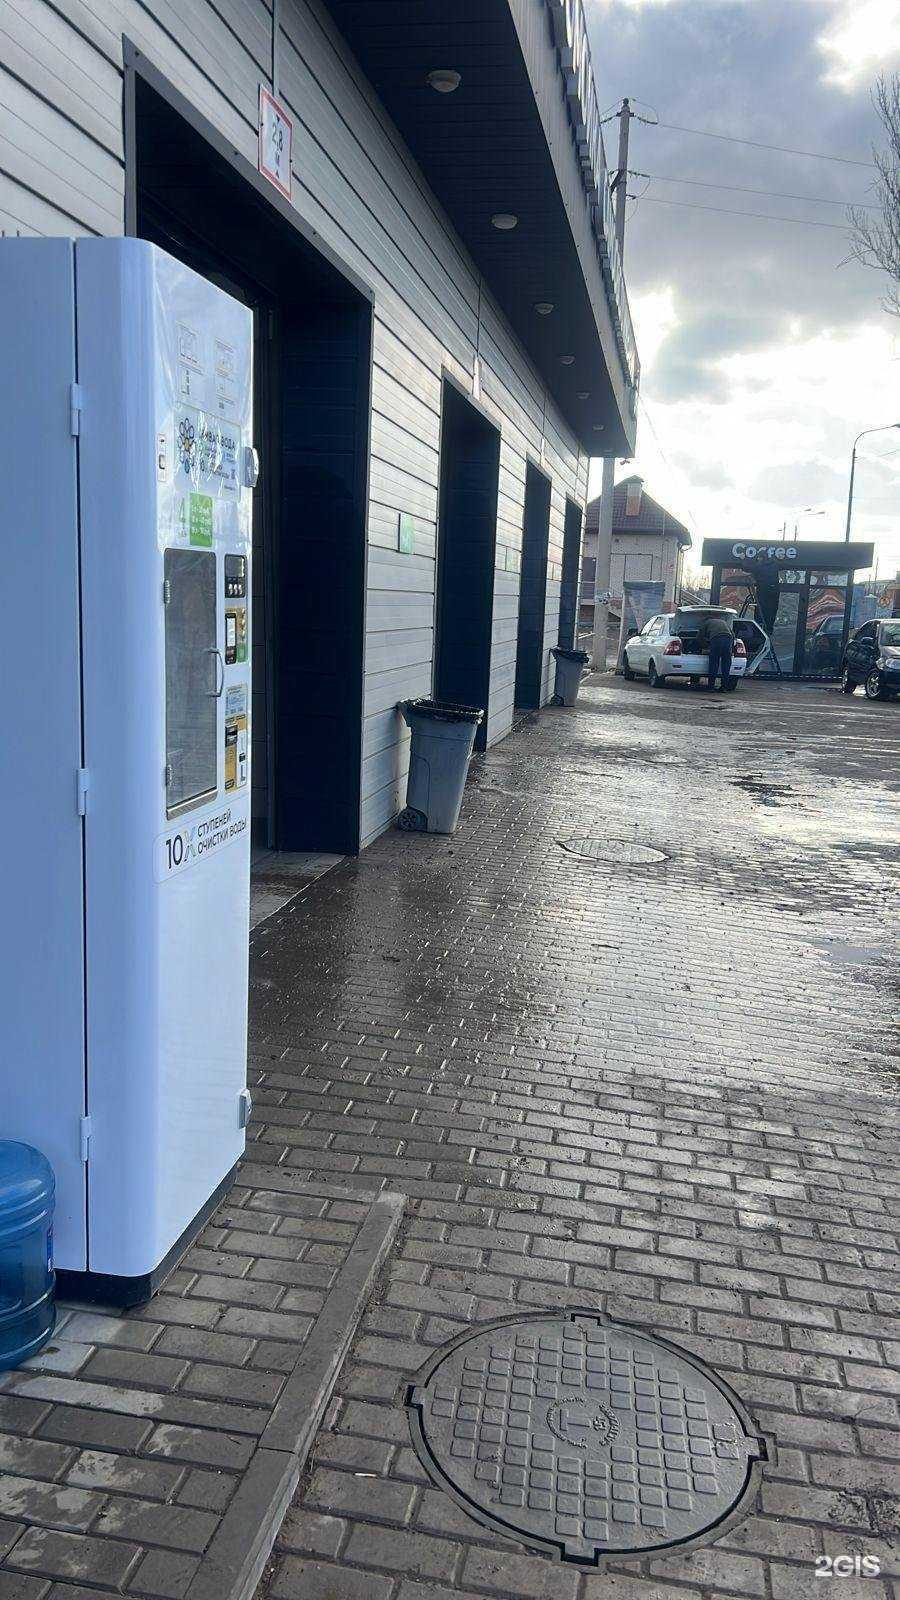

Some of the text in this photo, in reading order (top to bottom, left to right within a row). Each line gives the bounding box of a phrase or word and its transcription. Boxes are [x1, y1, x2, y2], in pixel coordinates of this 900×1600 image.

[197, 808, 232, 838] СТУПЕНЕЙ
[197, 817, 247, 855] ОЧИСТКИ ВОДЫ
